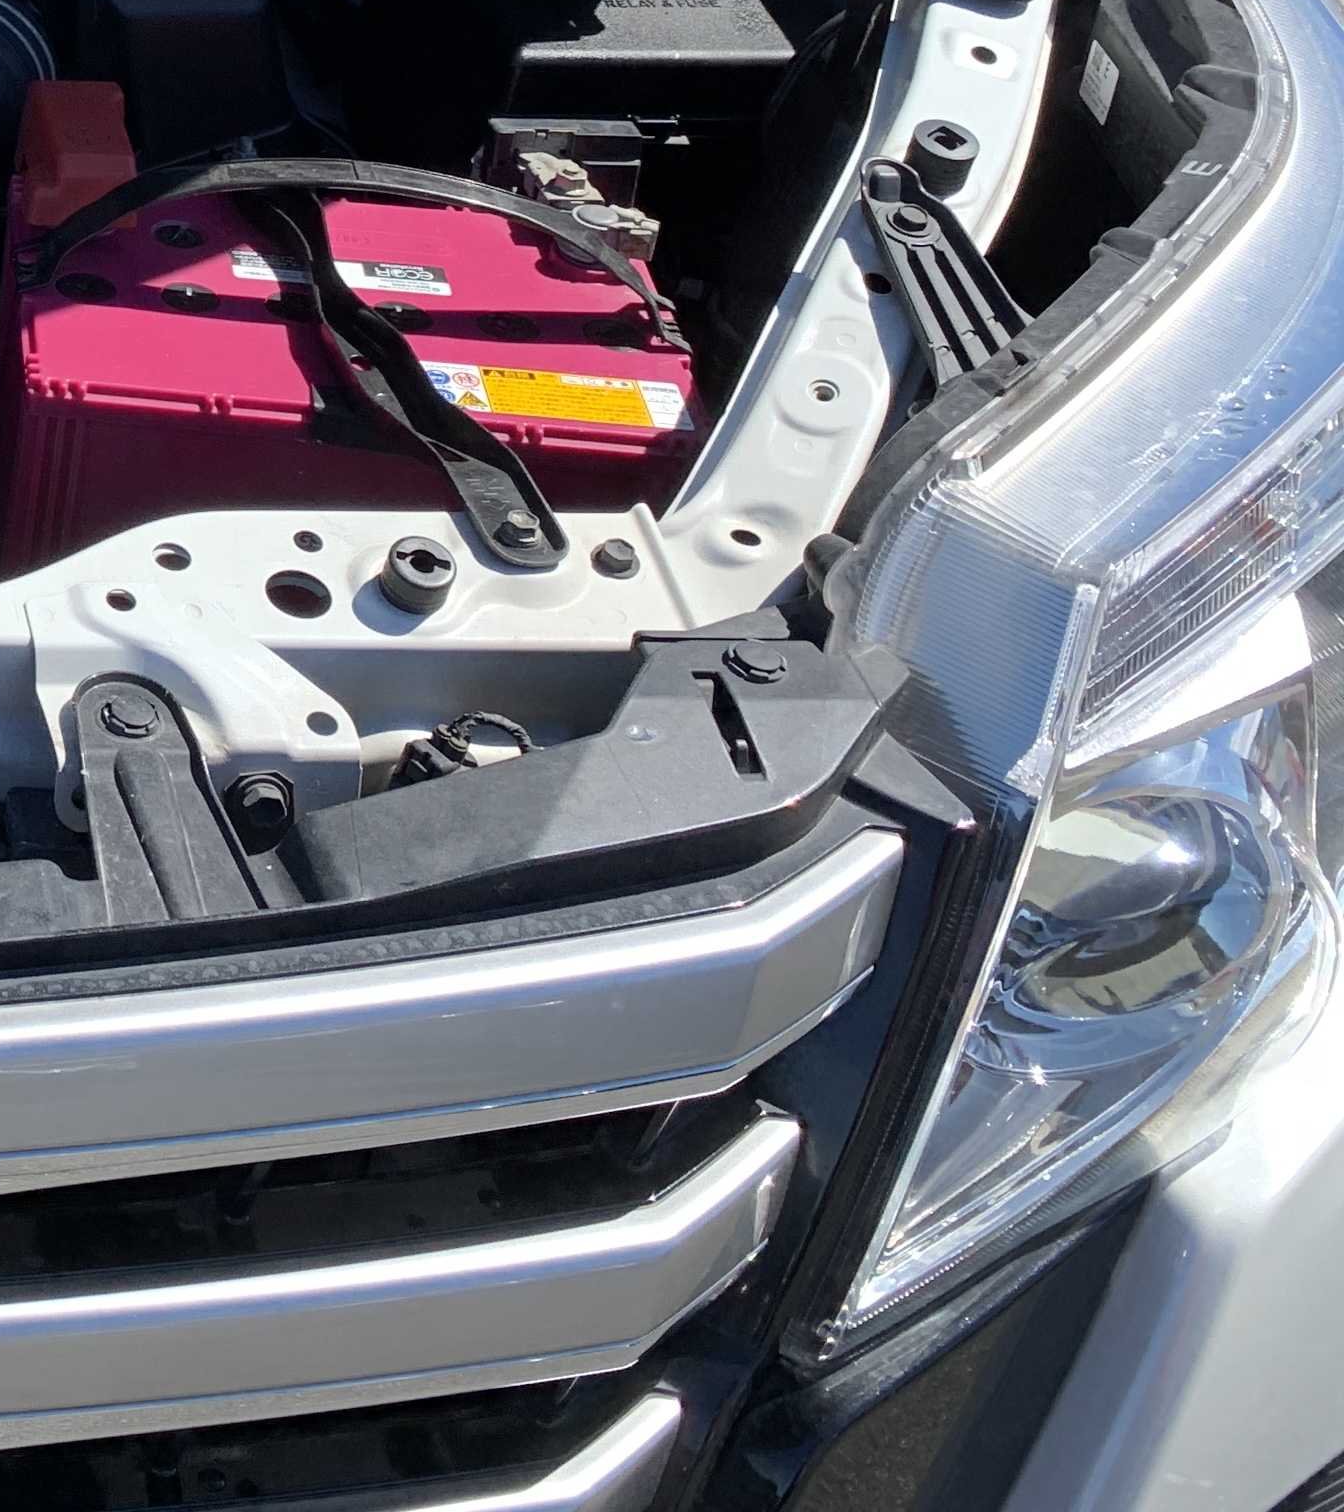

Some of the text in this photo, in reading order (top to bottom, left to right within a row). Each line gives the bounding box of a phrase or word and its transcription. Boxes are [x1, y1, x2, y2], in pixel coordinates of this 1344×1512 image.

[603, 0, 721, 8] RELAY & FUSE
